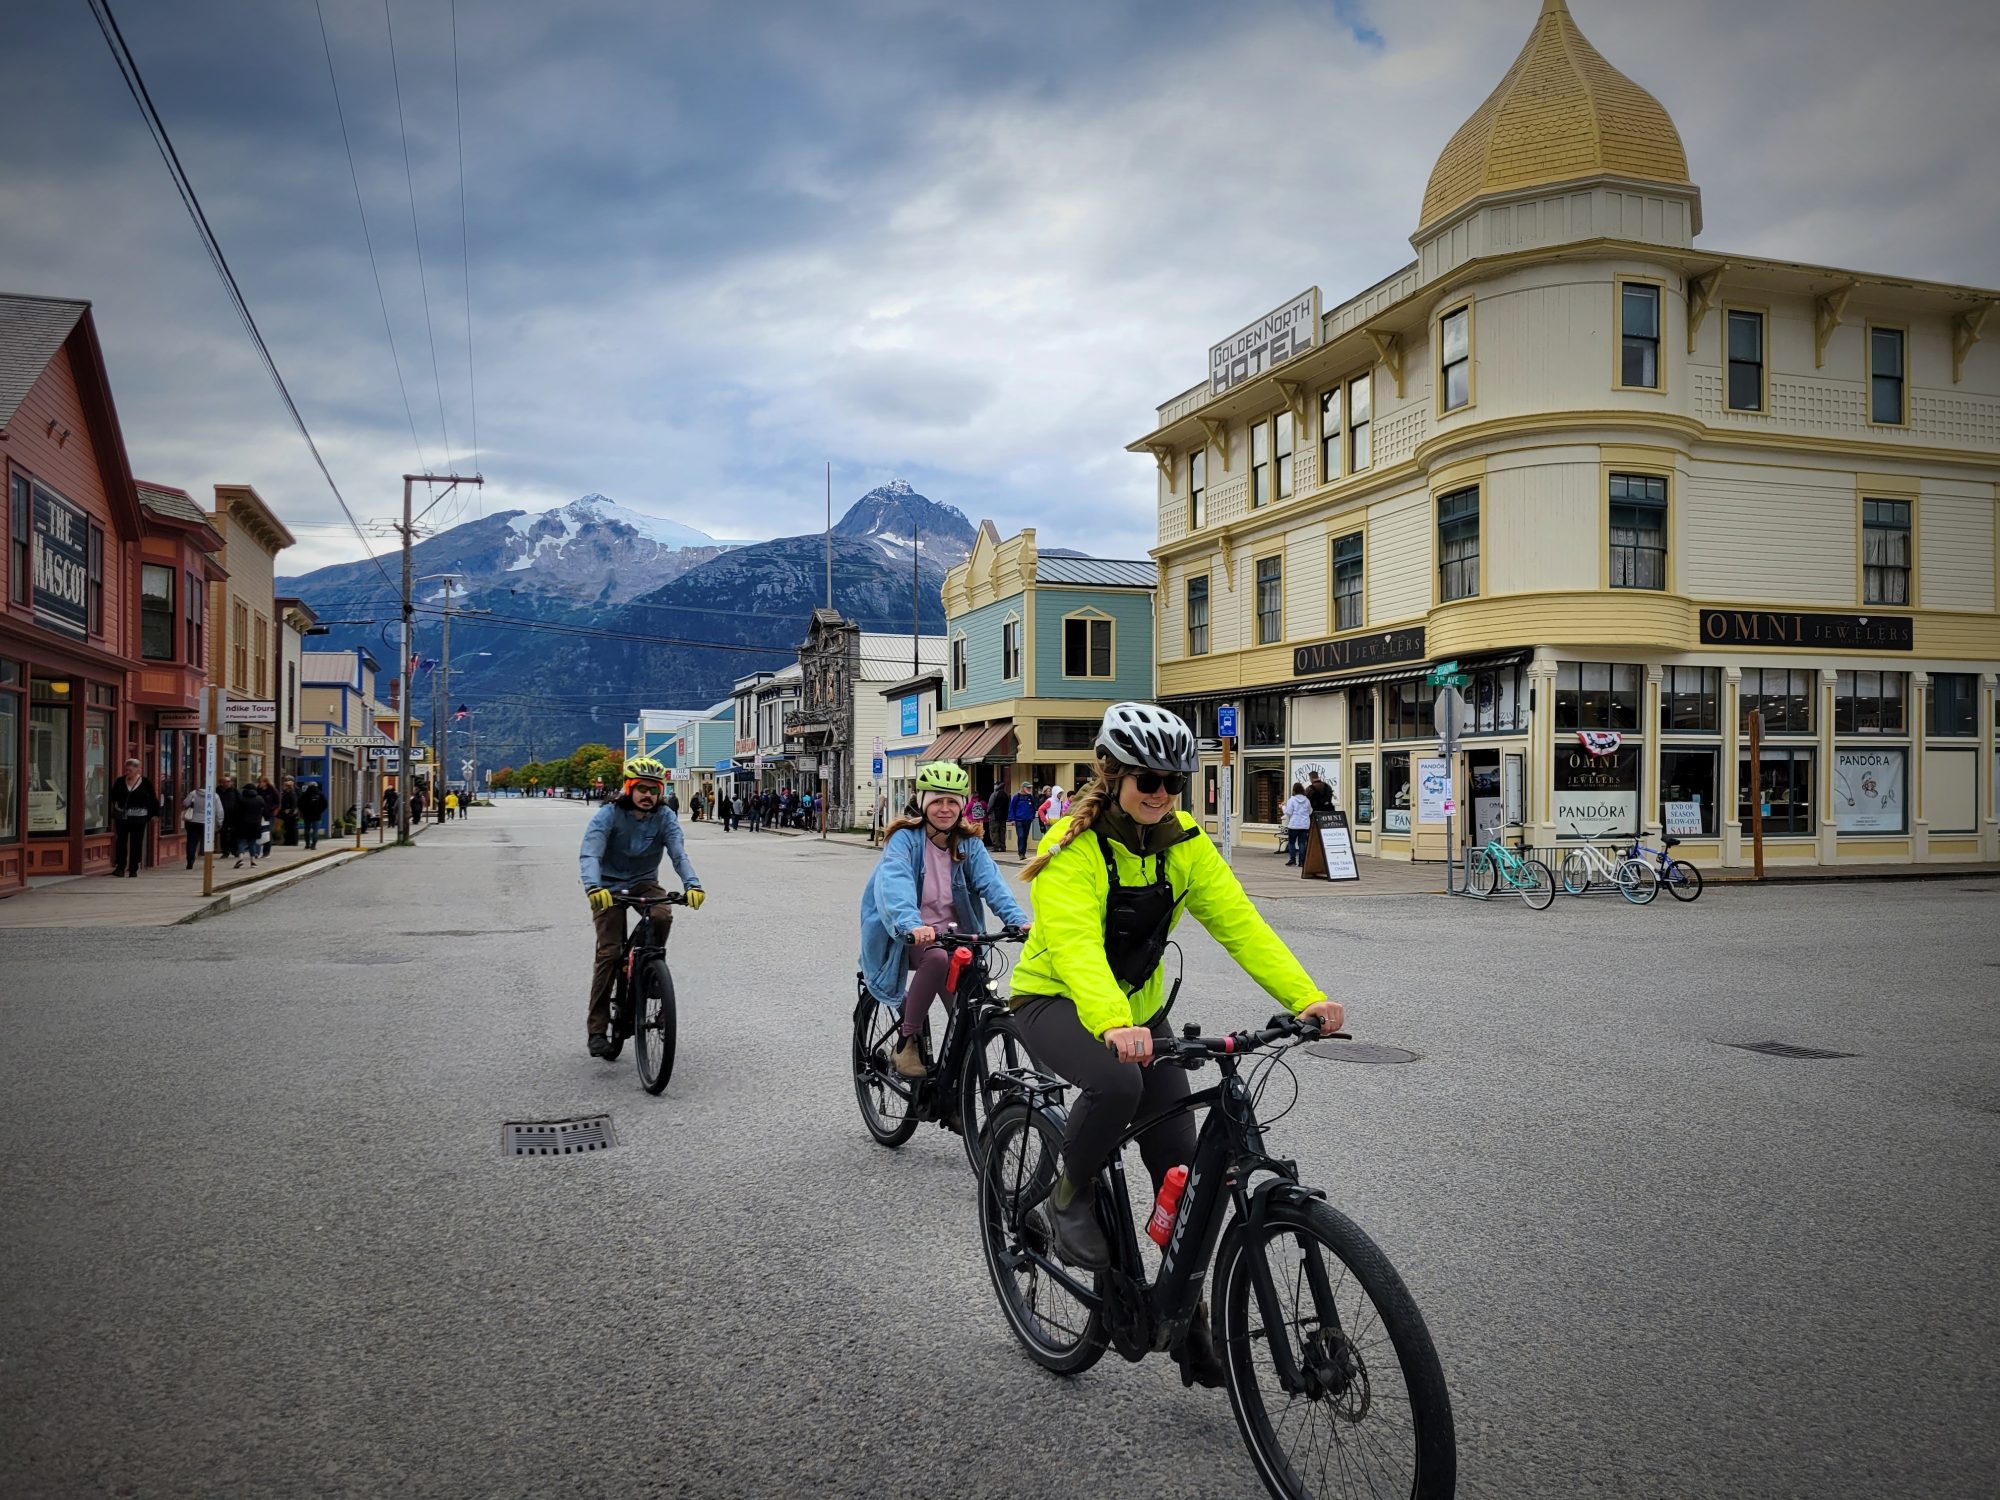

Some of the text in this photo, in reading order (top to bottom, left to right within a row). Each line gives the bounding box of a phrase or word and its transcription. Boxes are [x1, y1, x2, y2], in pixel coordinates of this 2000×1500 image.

[1214, 299, 1310, 368] GOLDEN NORTH
[1213, 325, 1312, 397] HOTEL
[48, 500, 73, 546] THE
[33, 531, 87, 608] MASCOT
[1706, 613, 1909, 642] OMNI JEWELERS
[1297, 638, 1420, 671] OMNI JEWELERS
[1447, 676, 1460, 684] AVE
[303, 736, 384, 744] FRESH LOCAL ART
[1569, 753, 1620, 768] OMNI
[1839, 754, 1890, 766] PANDORA
[1294, 763, 1326, 780] FRONTIER
[1567, 776, 1620, 784] JEWELERS
[1559, 803, 1626, 818] PANDORA
[1670, 826, 1697, 835] SALE!
[1163, 1163, 1202, 1274] TREK
